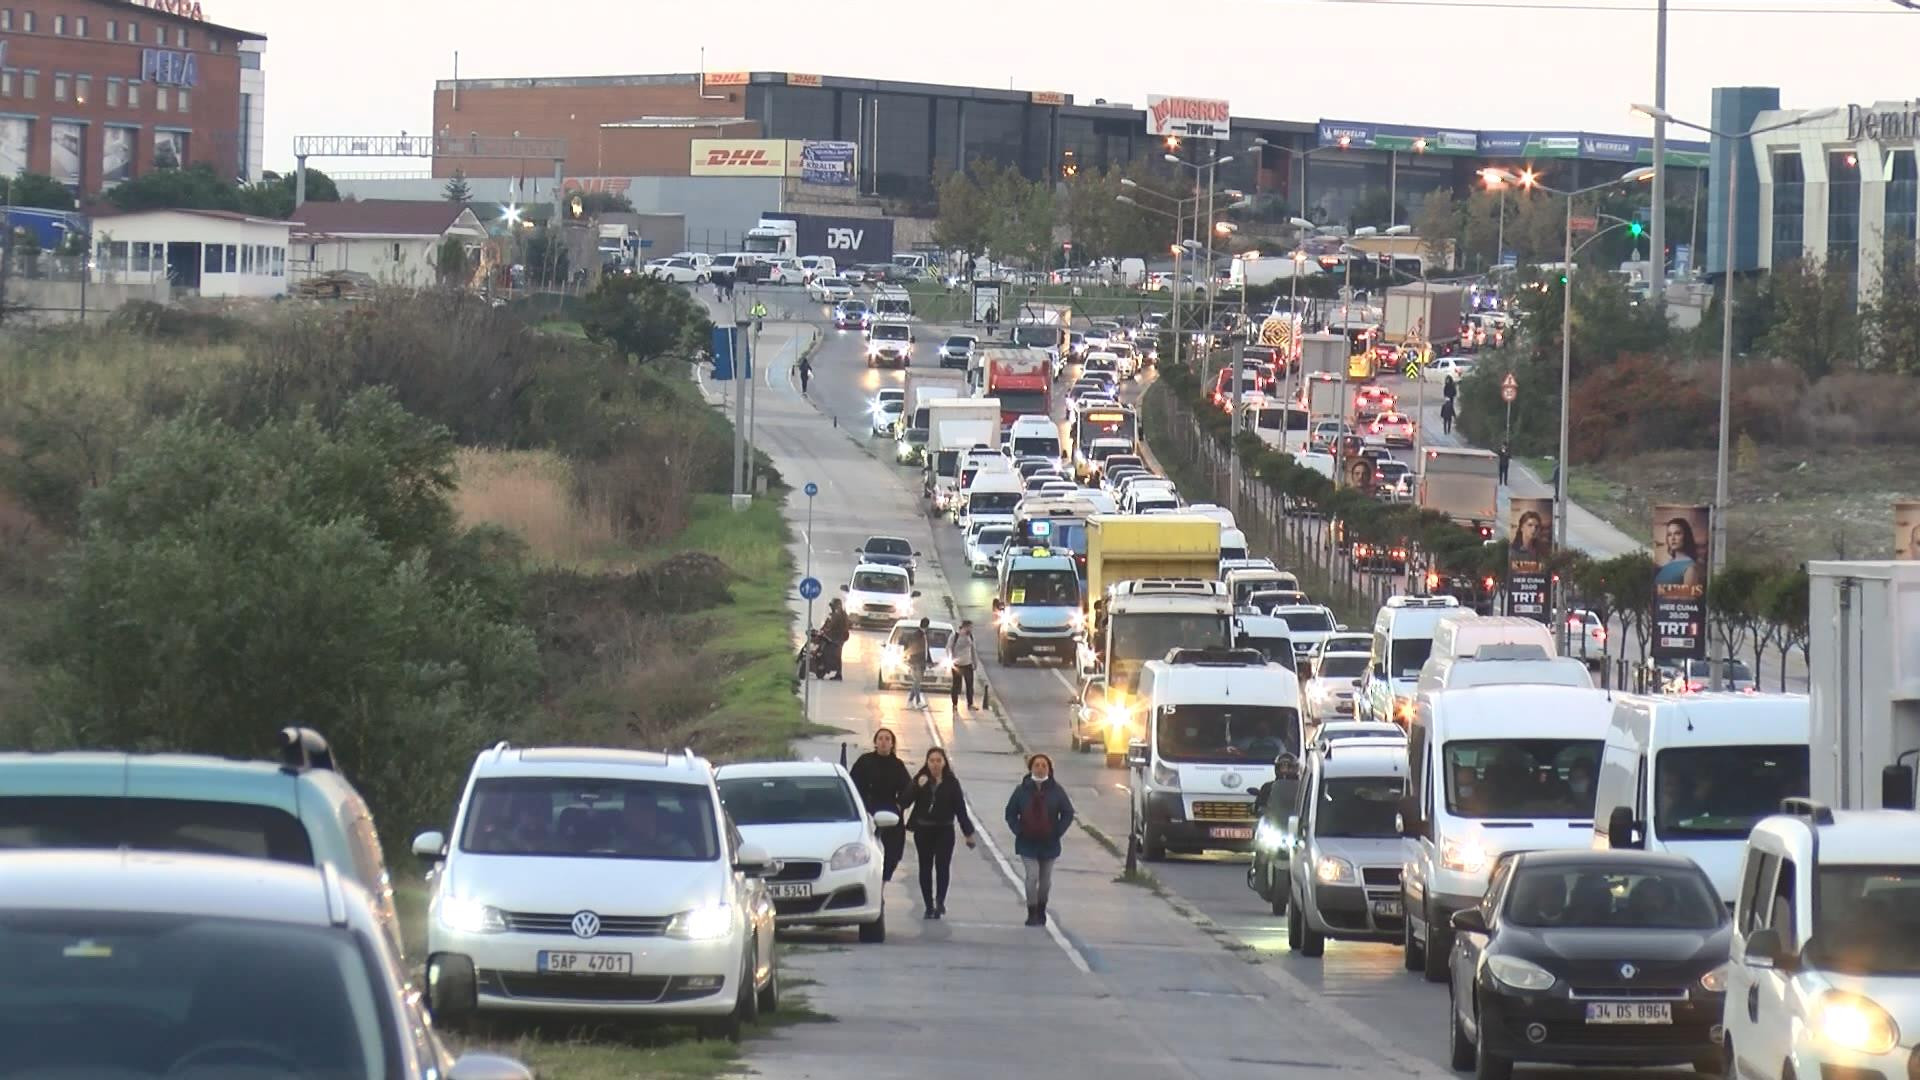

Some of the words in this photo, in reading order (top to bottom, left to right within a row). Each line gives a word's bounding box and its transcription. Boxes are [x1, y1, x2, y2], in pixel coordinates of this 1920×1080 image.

[1170, 98, 1228, 122] MIGROS
[1332, 127, 1367, 138] MICHELIN
[1596, 142, 1631, 152] MICHELIN
[707, 149, 769, 166] DHL
[827, 227, 864, 250] DSV
[1676, 604, 1699, 612] CUMA
[1657, 621, 1689, 635] TRT
[1162, 704, 1176, 715] 15
[551, 954, 577, 969] 5AP
[588, 955, 624, 971] 4701
[1596, 1004, 1611, 1019] 34
[1616, 1004, 1632, 1019] DS
[1638, 1004, 1669, 1019] 8964
